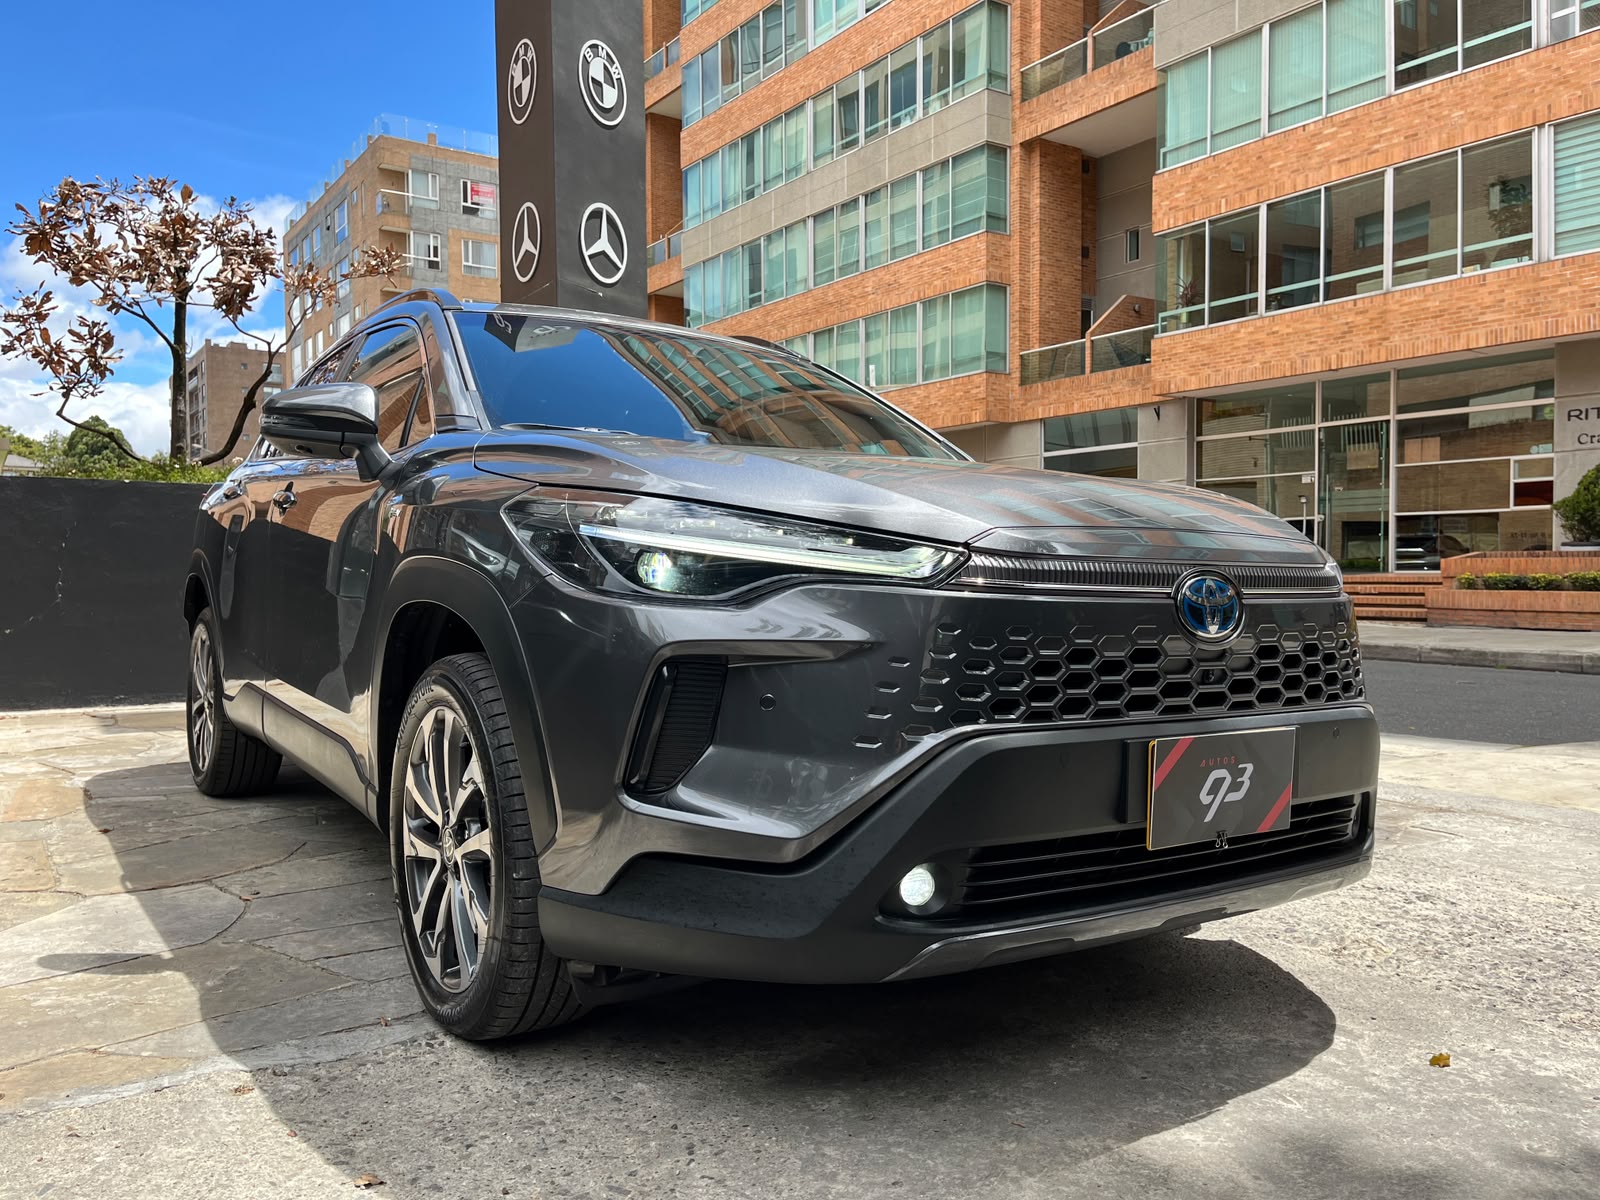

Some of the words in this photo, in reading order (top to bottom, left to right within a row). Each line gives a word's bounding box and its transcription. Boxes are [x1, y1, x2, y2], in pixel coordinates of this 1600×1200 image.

[584, 45, 621, 80] BMW
[1200, 756, 1236, 767] AUTOS
[1200, 763, 1254, 822] 93
